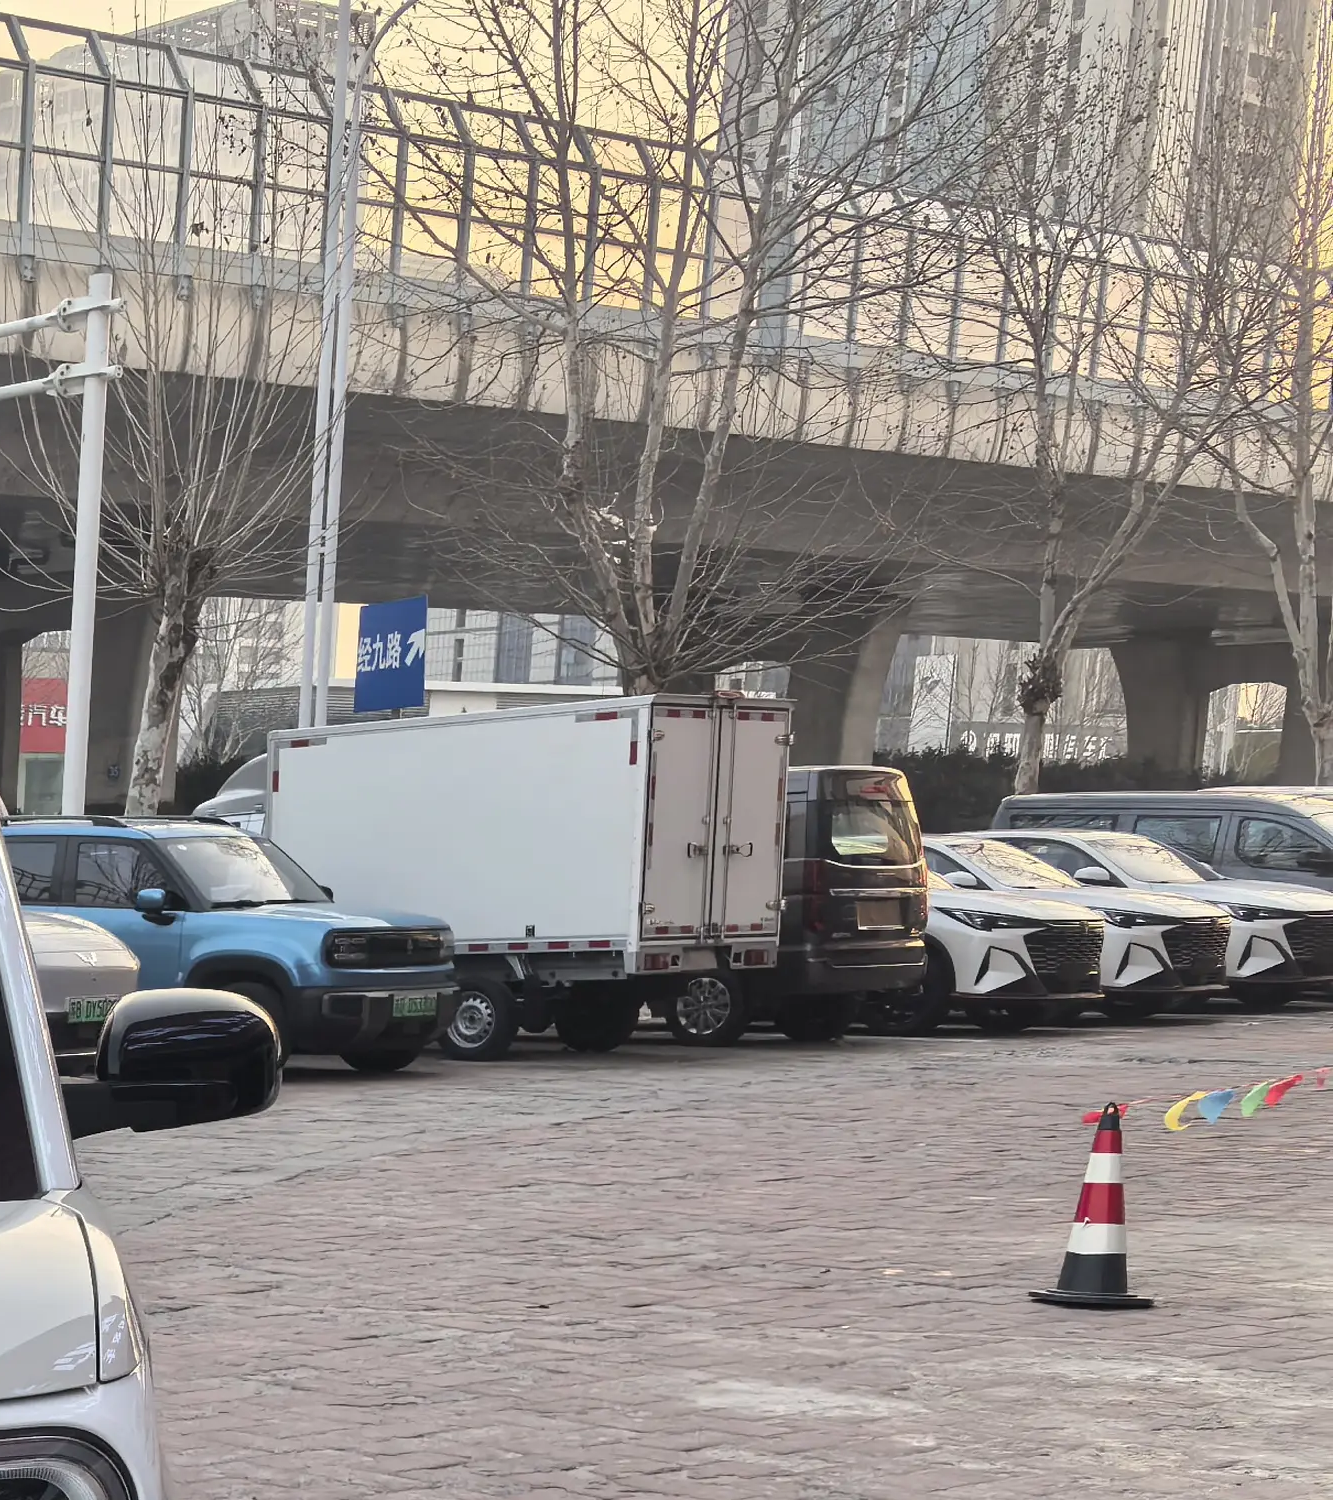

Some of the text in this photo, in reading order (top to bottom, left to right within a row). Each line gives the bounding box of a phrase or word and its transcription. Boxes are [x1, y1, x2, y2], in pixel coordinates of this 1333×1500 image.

[357, 631, 402, 672] 经九路
[20, 704, 68, 726] 汽车
